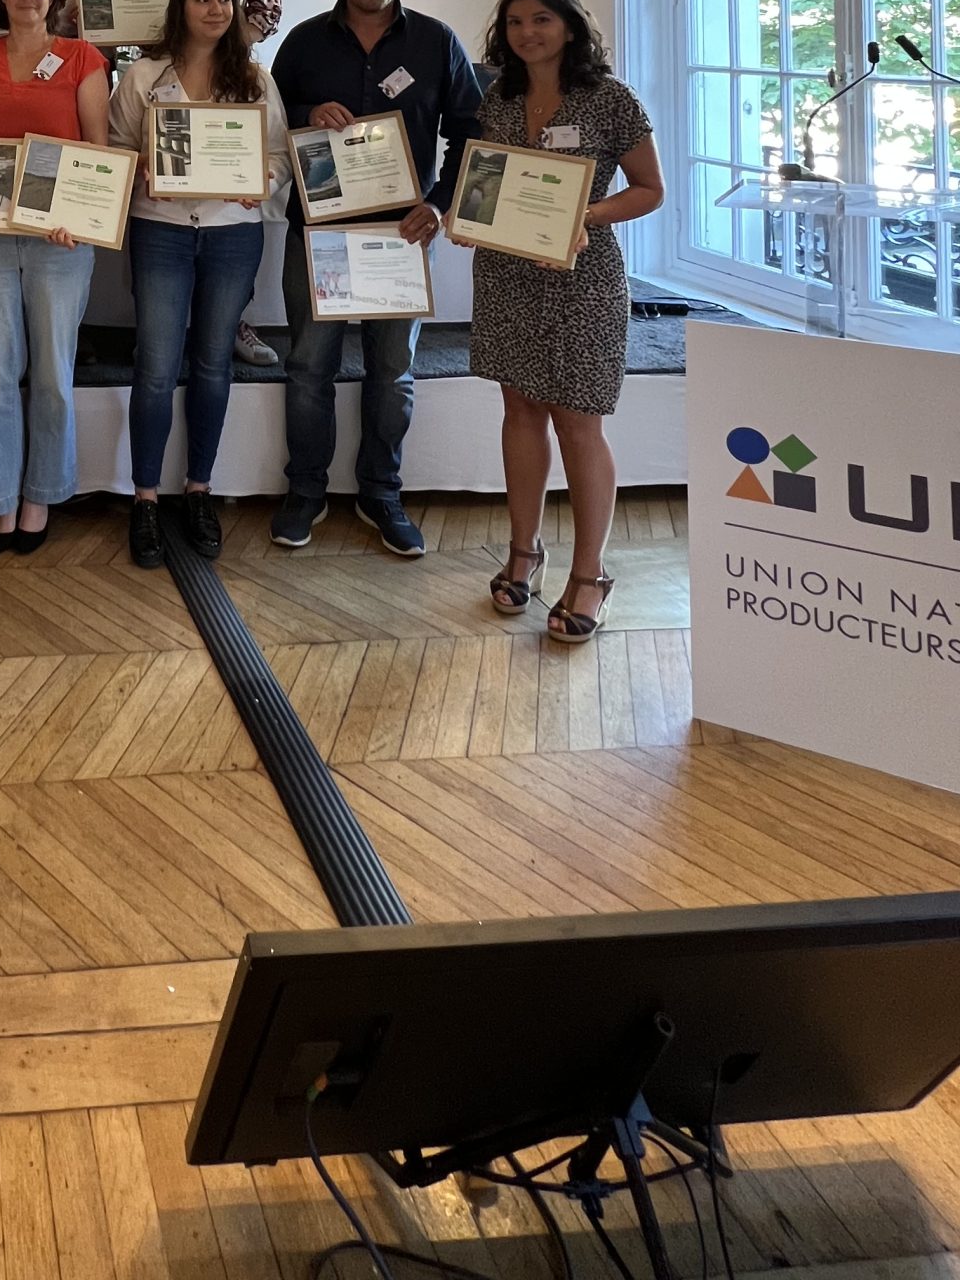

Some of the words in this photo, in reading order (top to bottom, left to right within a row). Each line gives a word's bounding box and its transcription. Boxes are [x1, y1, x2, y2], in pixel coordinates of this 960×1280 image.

[847, 463, 960, 541] U
[726, 553, 863, 605] UNION
[890, 589, 960, 626] NA
[727, 587, 960, 664] PRODUCTEURS
